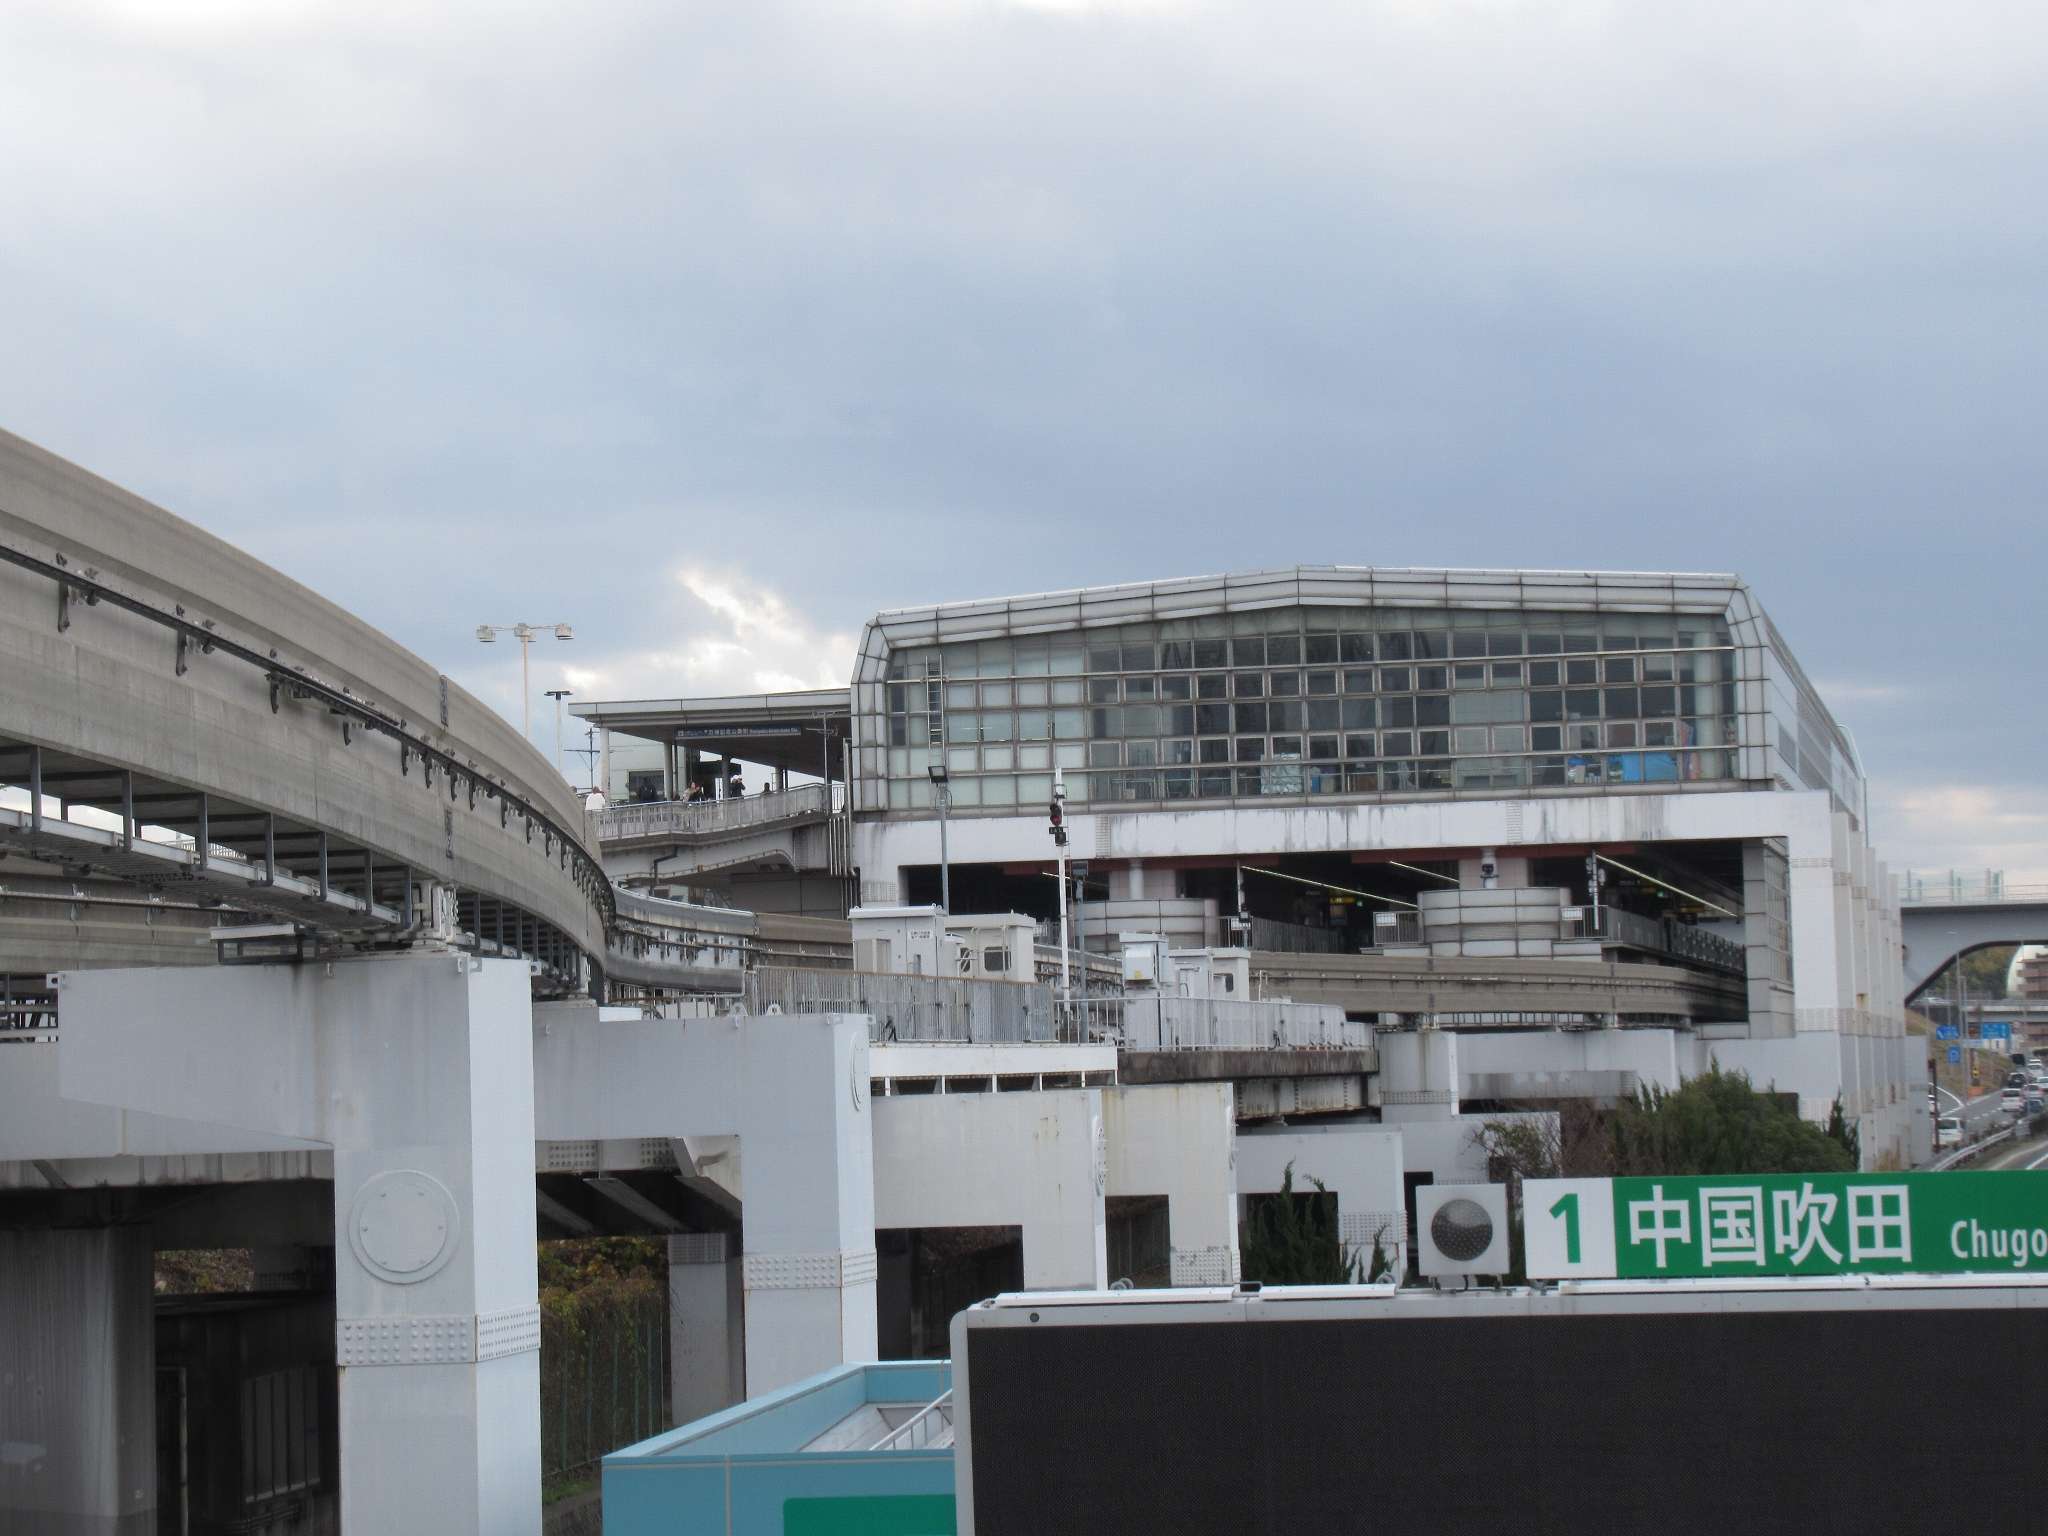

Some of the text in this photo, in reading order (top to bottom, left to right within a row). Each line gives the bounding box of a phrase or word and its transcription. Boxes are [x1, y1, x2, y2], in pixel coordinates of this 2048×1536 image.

[1549, 1182, 2048, 1268] 1 中国吹田 Chugo
